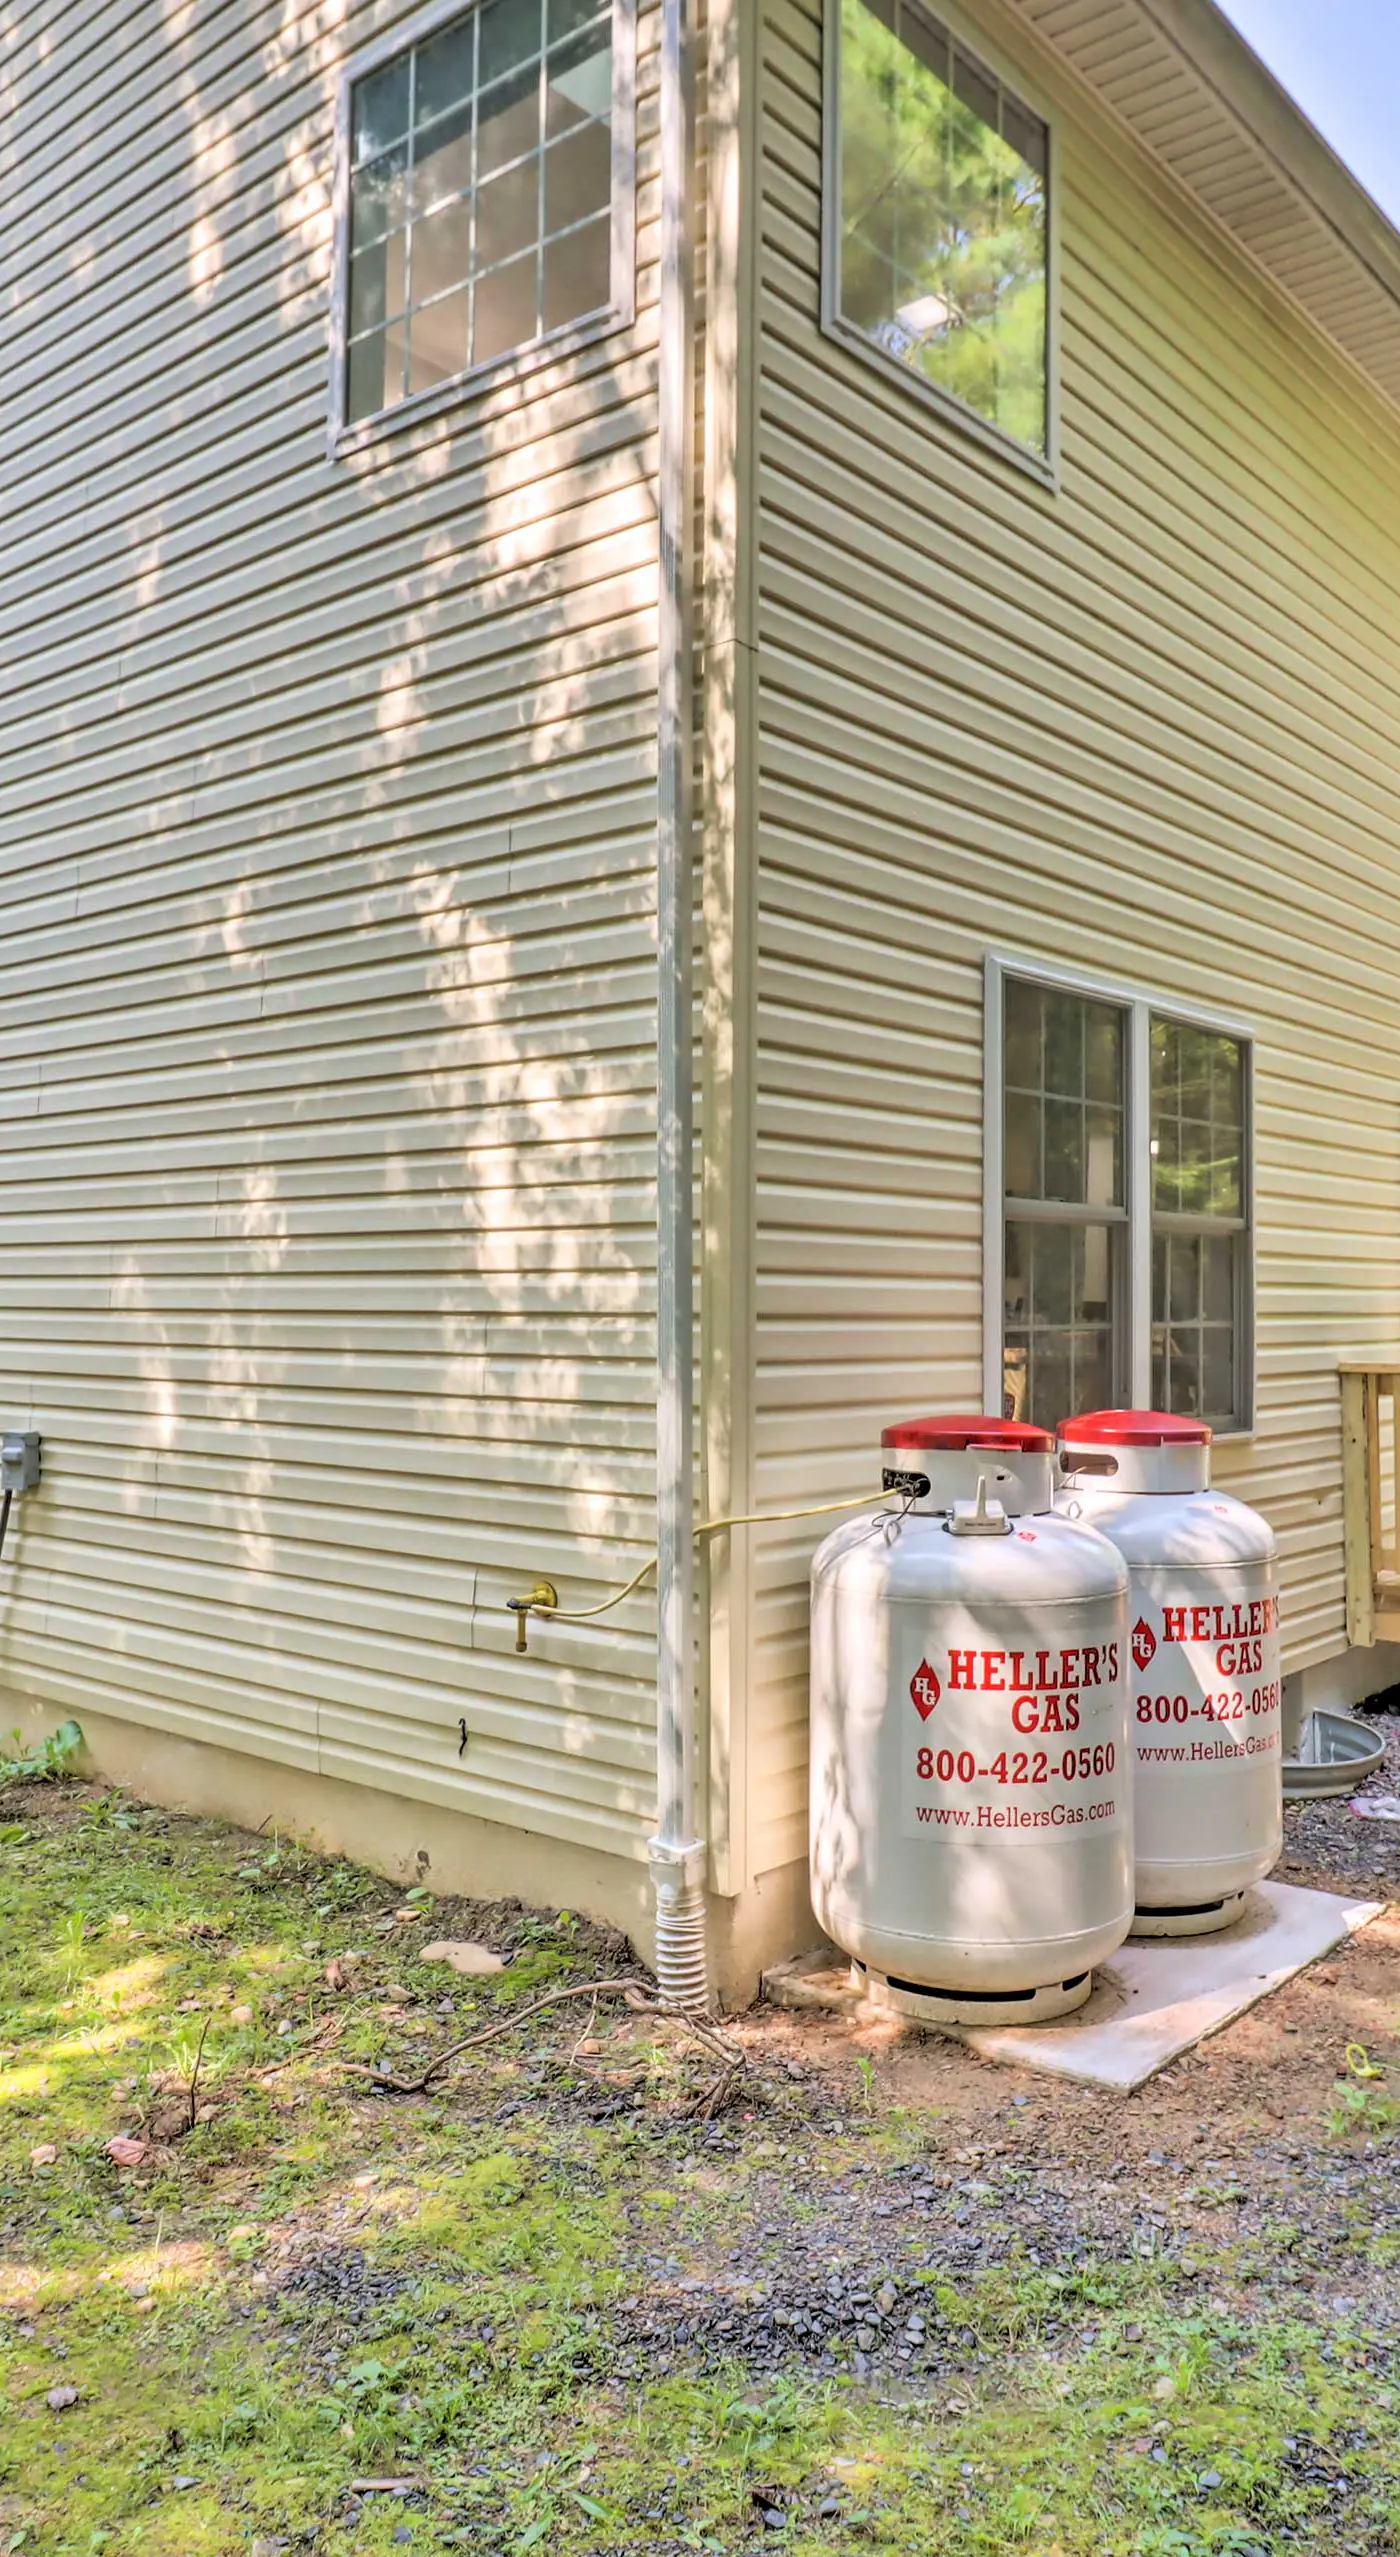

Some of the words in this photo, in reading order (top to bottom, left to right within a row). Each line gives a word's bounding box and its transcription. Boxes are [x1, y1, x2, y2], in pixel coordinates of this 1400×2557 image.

[948, 1643, 1118, 1691] HELLER'S
[1216, 1640, 1262, 1676] GAS
[1011, 1693, 1080, 1734] GAS
[916, 1742, 1115, 1784] 800-422-0560
[916, 1800, 1115, 1828] www.HellersGas.com
